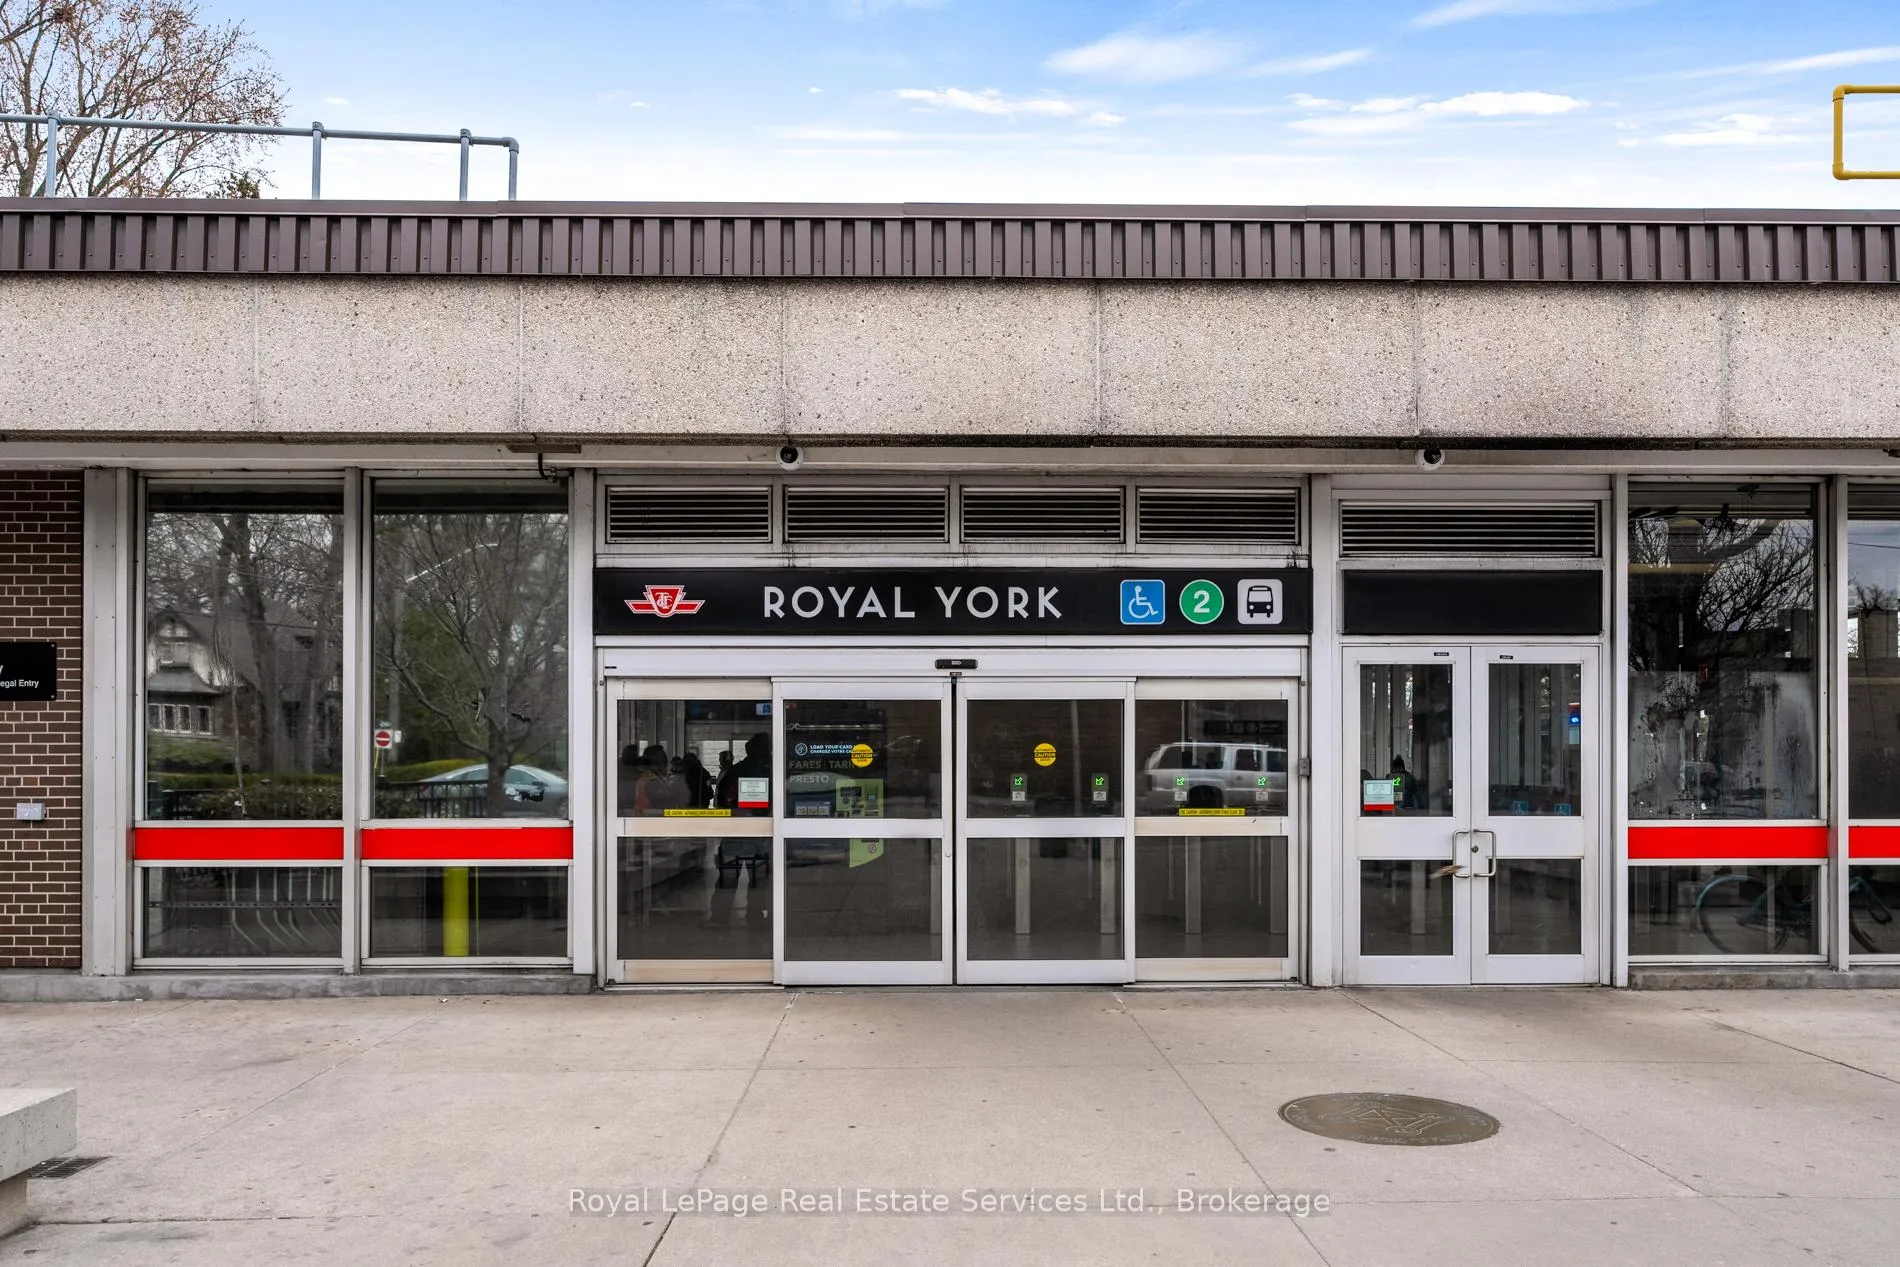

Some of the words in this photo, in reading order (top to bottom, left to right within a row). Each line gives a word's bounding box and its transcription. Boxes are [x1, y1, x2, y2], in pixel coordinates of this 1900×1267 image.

[764, 586, 915, 618] ROYAL
[935, 586, 1062, 618] YORK
[1193, 590, 1211, 613] 2
[19, 680, 39, 688] Entry
[789, 760, 821, 769] FARES
[790, 775, 829, 783] PRESTO
